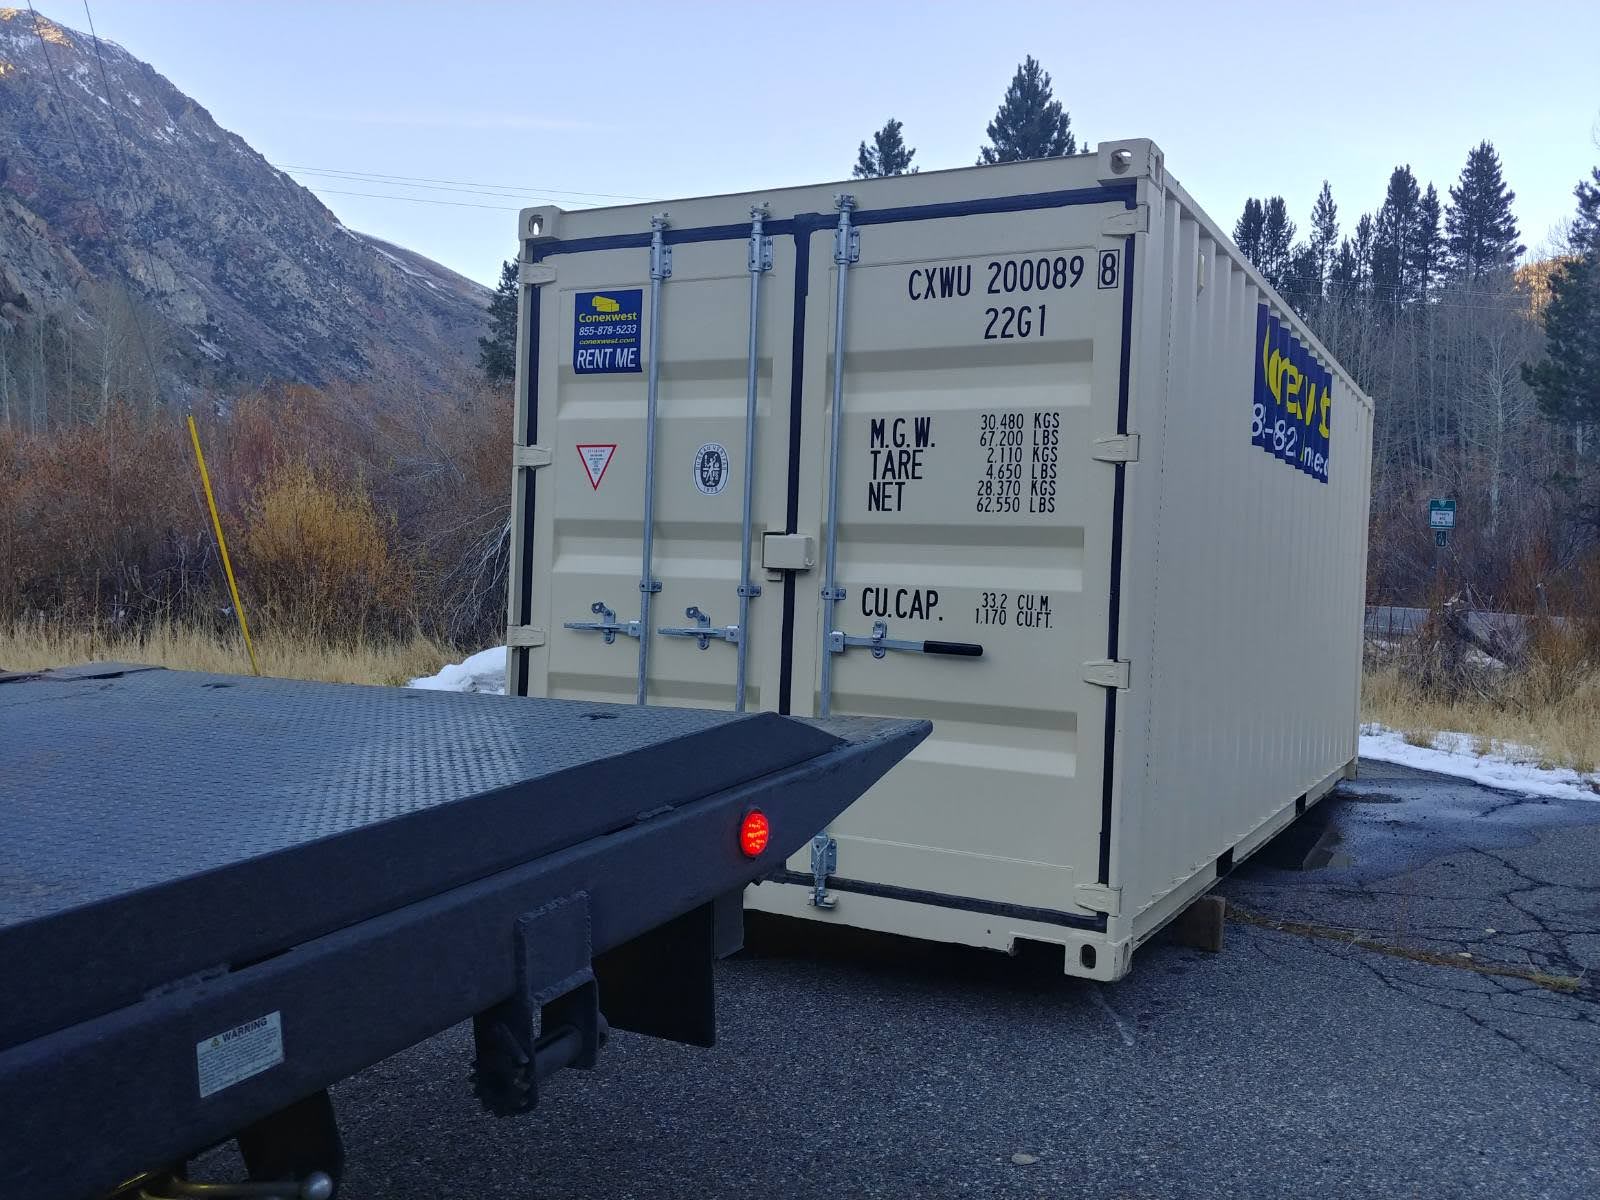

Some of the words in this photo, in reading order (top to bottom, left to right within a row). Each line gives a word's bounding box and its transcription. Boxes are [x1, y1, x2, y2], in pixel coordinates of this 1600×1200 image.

[908, 264, 971, 300] CXWU
[987, 255, 1084, 294] 200089
[1101, 252, 1116, 286] 8
[578, 311, 637, 323] Conexwest
[984, 304, 1046, 339] 22G1
[578, 325, 637, 336] 855-878-5233
[577, 348, 613, 369] RENT
[615, 347, 638, 368] ME
[1034, 412, 1060, 429] KGS
[870, 416, 936, 449] M.G.W.
[1033, 429, 1059, 446] LBS
[1032, 446, 1058, 463] KGS
[870, 449, 924, 480] TARE
[1031, 463, 1057, 479] LBS
[867, 481, 906, 512] NET
[1030, 480, 1056, 496] KGS
[1029, 496, 1055, 513] LBS
[861, 587, 943, 621] CU.CAP.
[982, 592, 1008, 609] 33.2
[222, 1017, 268, 1042] WARNING
